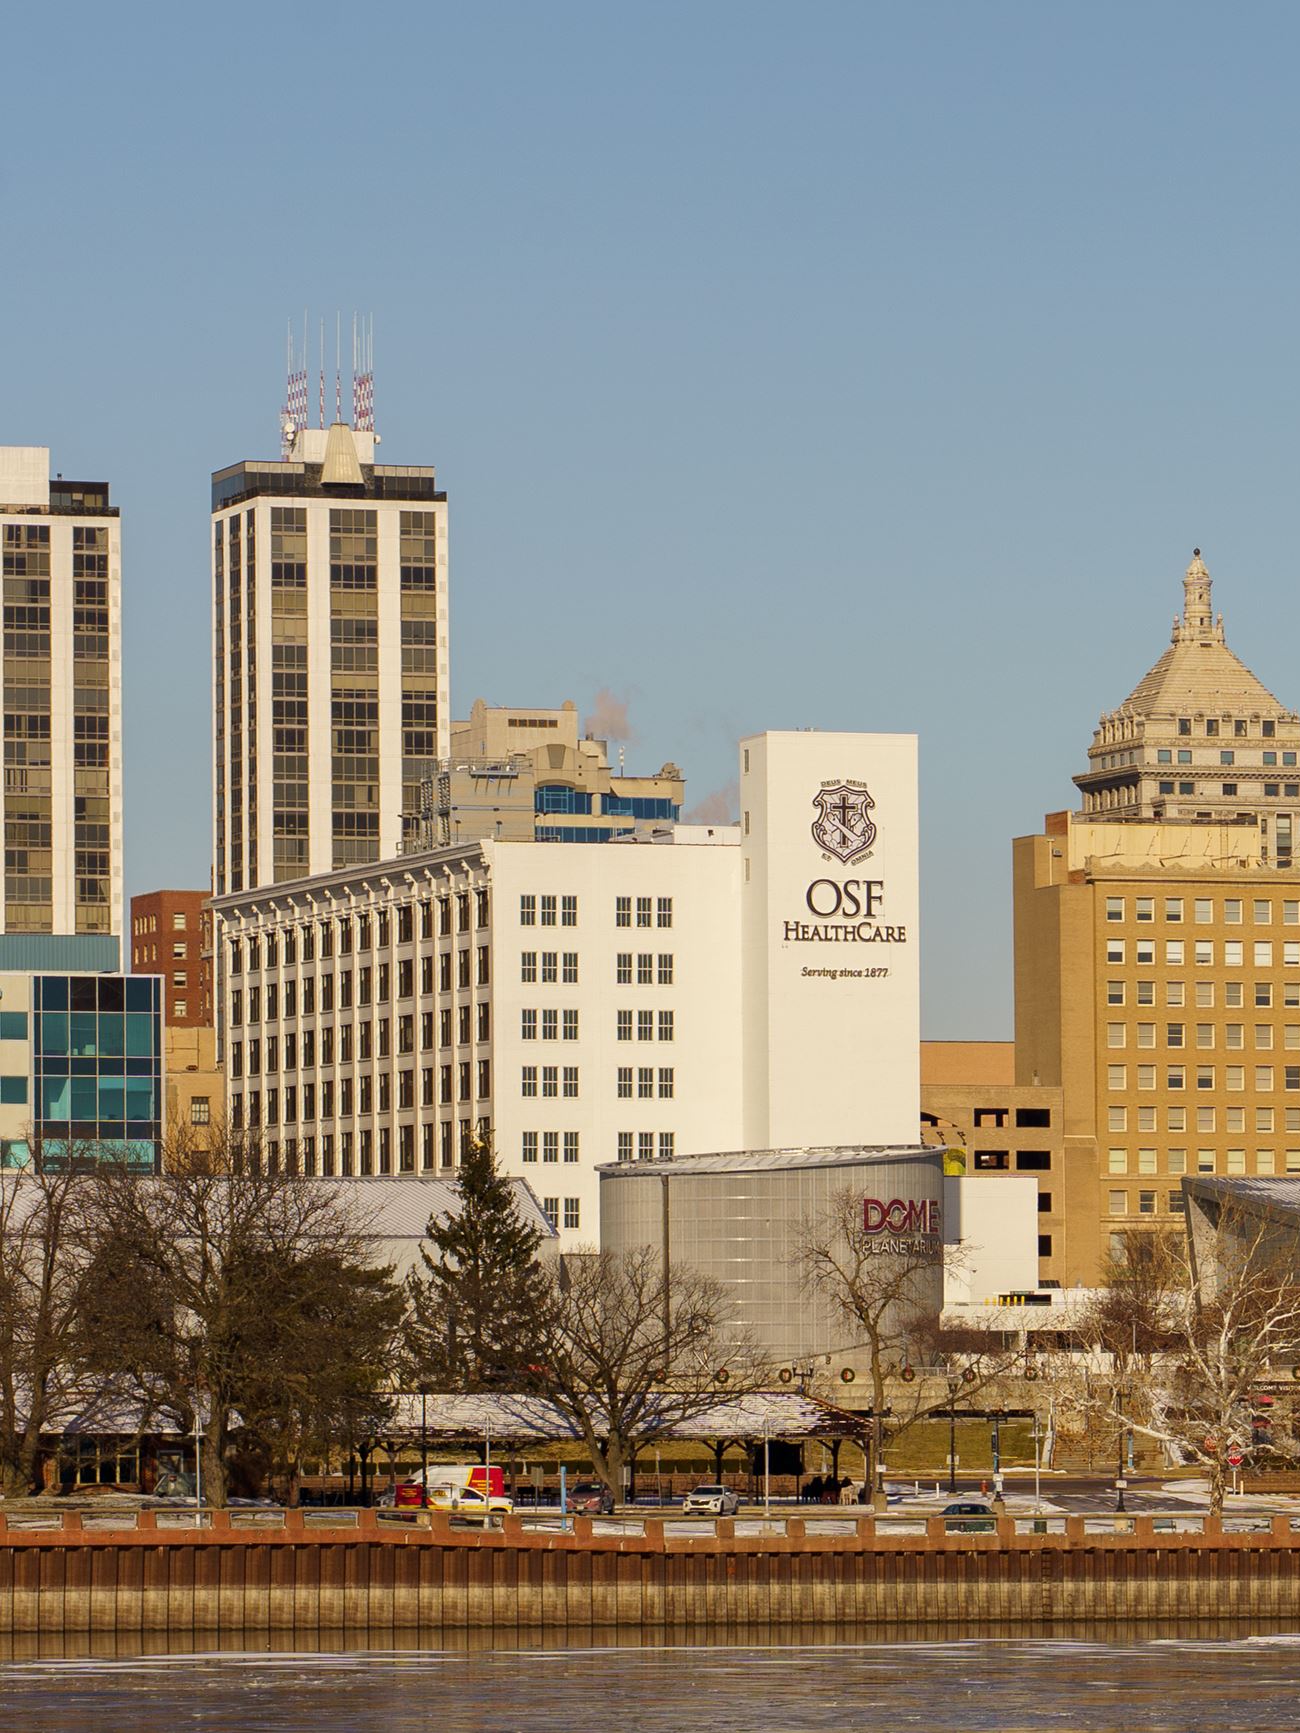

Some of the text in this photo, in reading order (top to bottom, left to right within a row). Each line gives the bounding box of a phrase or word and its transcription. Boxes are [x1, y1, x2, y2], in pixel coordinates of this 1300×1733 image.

[820, 779, 867, 788] DEUS MEUS
[851, 850, 874, 866] OMNIA
[806, 879, 884, 918] OSF
[801, 966, 888, 980] Serving since 1877
[863, 1199, 939, 1233] DOME
